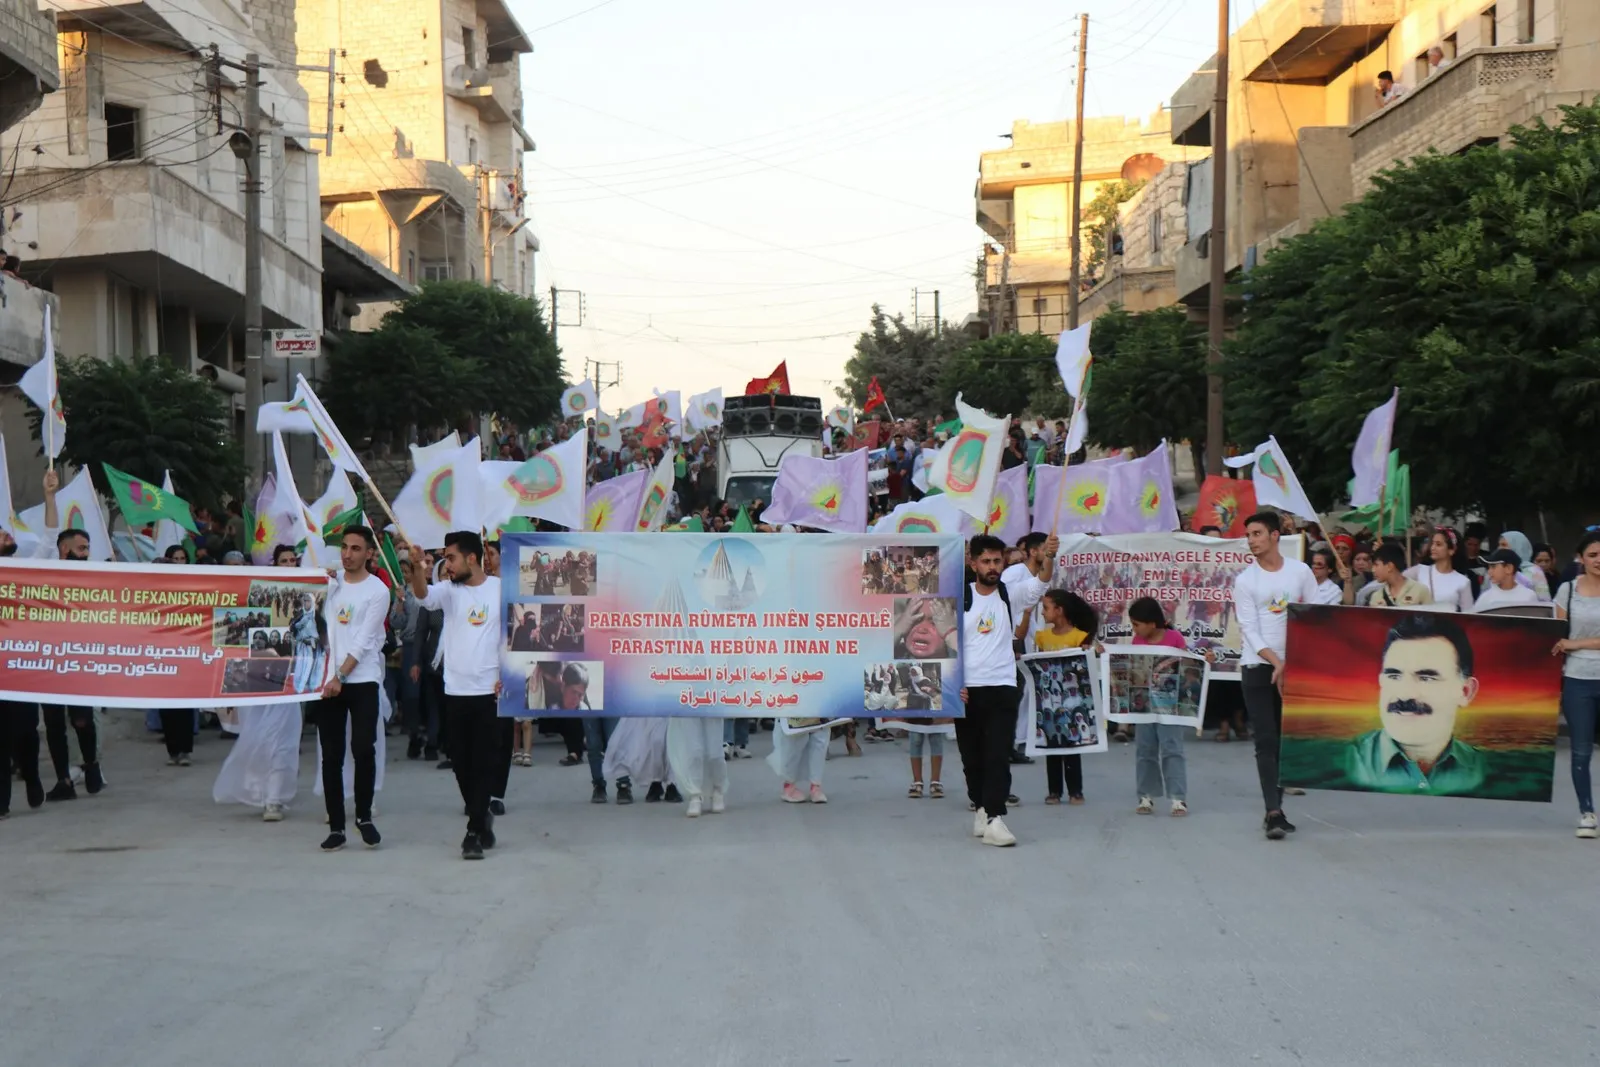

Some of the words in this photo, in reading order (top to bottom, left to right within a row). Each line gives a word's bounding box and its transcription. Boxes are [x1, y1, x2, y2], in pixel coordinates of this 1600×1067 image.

[1060, 555, 1070, 567] BI
[1175, 549, 1211, 563] GELÊ
[1144, 569, 1165, 581] EM
[1171, 567, 1179, 581] Ê
[19, 584, 60, 601] JINÊN
[63, 587, 118, 605] ŞENGAL
[121, 587, 131, 604] Û
[133, 590, 220, 606] EFXANISTANÎ
[220, 593, 239, 606] DE
[17, 604, 26, 620] Ê
[29, 608, 67, 622] BIBIN
[70, 608, 117, 624] DENGÊ
[120, 609, 160, 625] HEMÛ
[162, 613, 203, 626] JINAN
[589, 612, 684, 628] PARASTINA
[687, 609, 758, 628] RÛMETA
[763, 608, 810, 628] JINÊN
[815, 608, 891, 632] ŞENGALÊ
[42, 644, 52, 656] و
[54, 642, 105, 656] شنكال
[107, 644, 142, 656] نساء
[144, 645, 200, 659] شخصية
[611, 639, 705, 655] PARASTINA
[709, 636, 779, 655] HEBÛNA
[783, 639, 830, 655] JINAN
[835, 639, 859, 655] NE
[202, 648, 224, 664] في
[7, 658, 54, 671] النساء
[56, 660, 81, 674] كل
[83, 660, 123, 675] صوت
[124, 662, 178, 677] سنكون
[650, 666, 712, 684] الشنكالية
[715, 664, 747, 684] المرأة
[750, 666, 789, 684] كرامة
[791, 668, 825, 684] صون
[680, 687, 717, 708] المرأة
[720, 689, 763, 708] كرامة
[766, 691, 799, 708] صون
